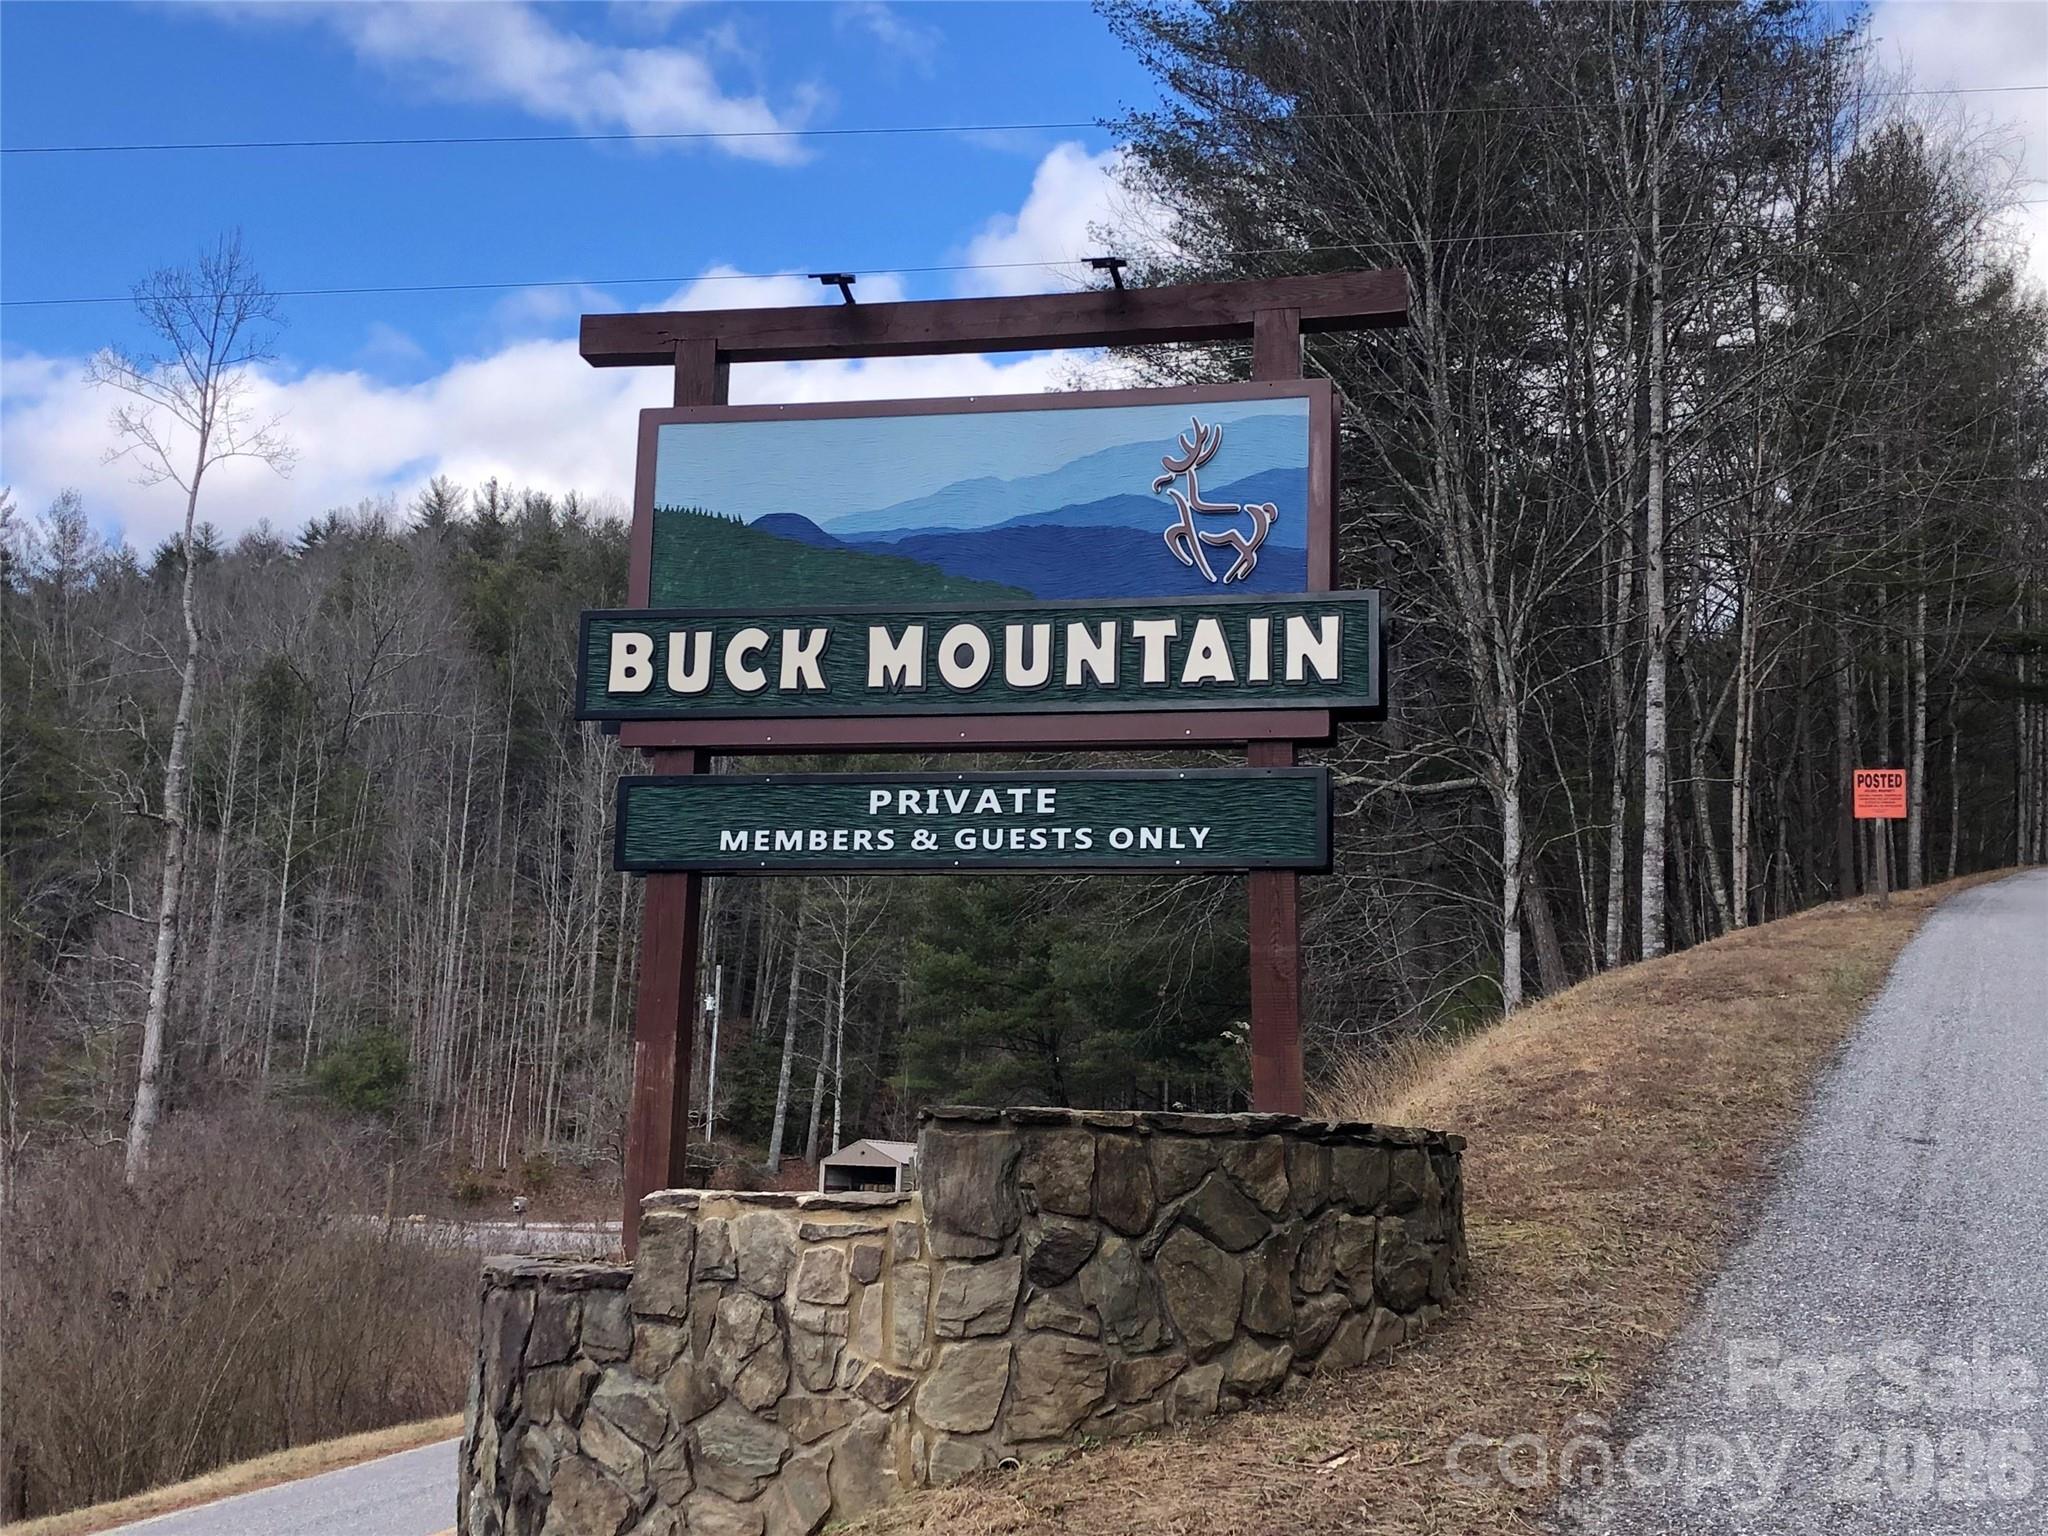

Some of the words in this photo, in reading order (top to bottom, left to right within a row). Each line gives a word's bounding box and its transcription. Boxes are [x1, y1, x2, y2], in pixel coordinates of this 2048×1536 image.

[607, 628, 828, 693] BUCK
[867, 615, 1341, 689] MOUNTAIN
[1857, 773, 1903, 788] POSTED
[869, 788, 1057, 815] PRIVATE
[719, 829, 895, 851] MEMBERS
[910, 828, 939, 851] &
[954, 827, 1093, 850] GUESTS
[1108, 826, 1211, 850] ONLY
